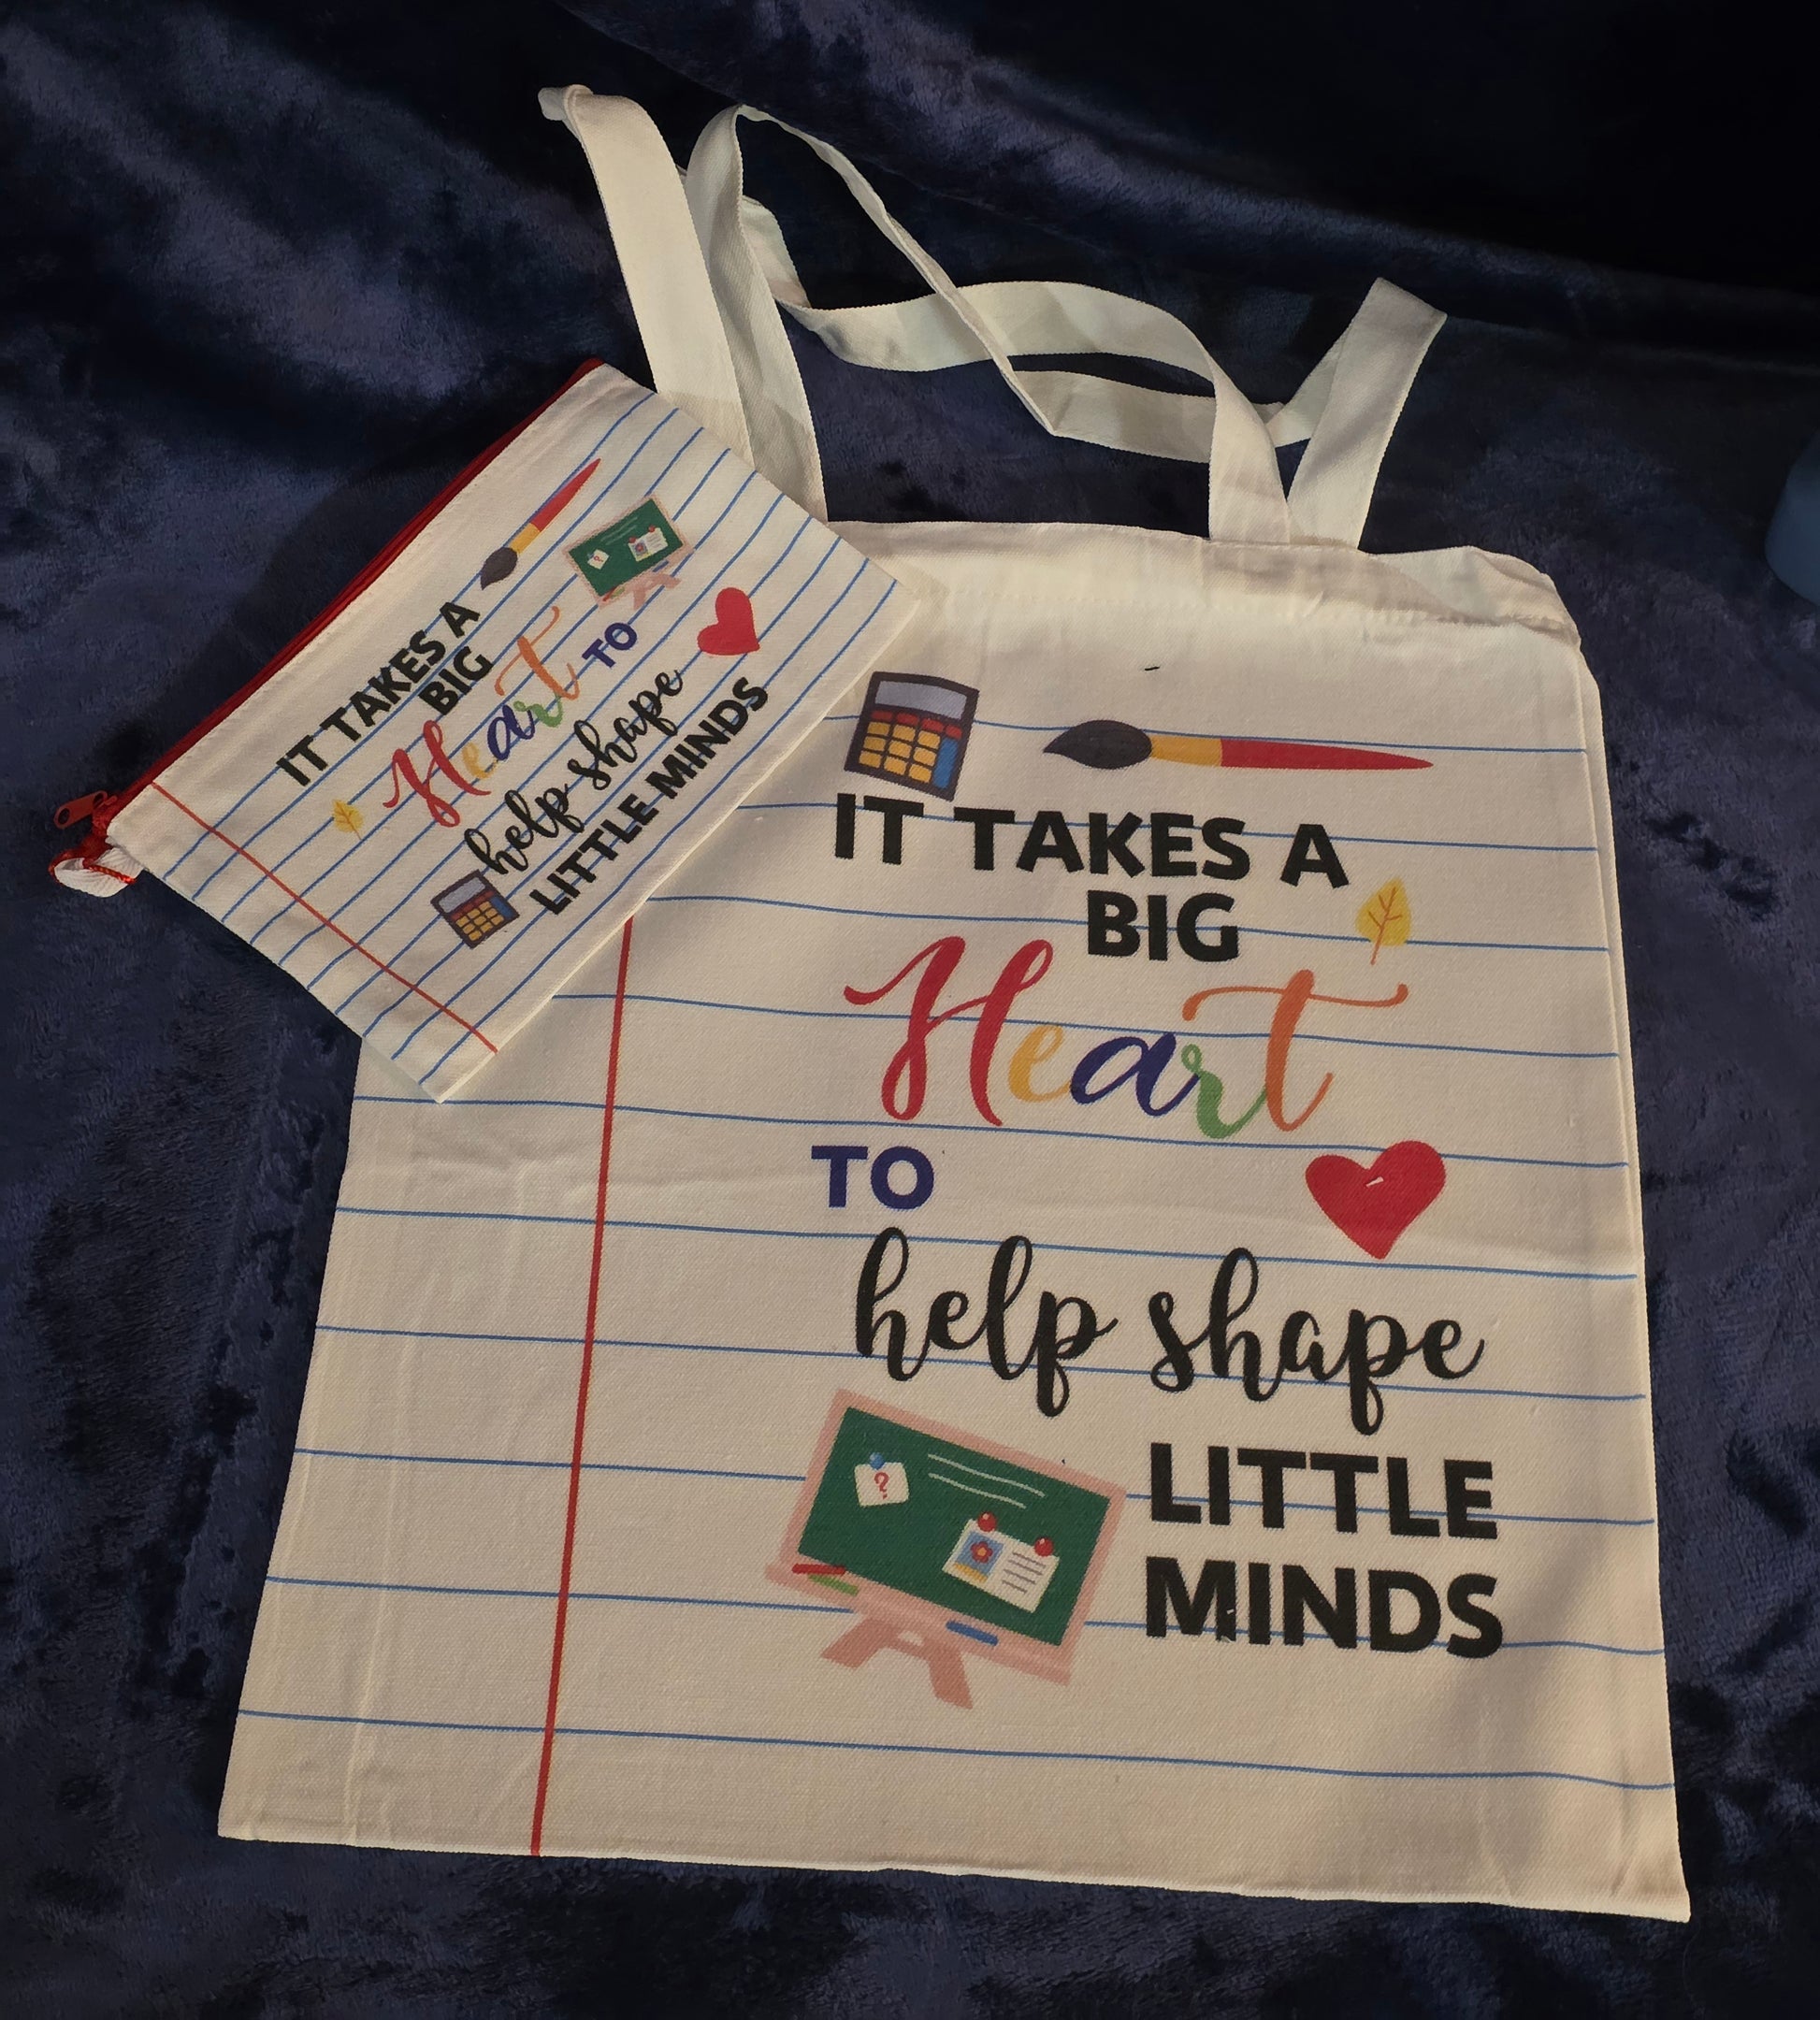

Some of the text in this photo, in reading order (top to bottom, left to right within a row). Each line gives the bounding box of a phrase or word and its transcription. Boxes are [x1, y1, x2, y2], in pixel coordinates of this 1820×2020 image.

[276, 601, 481, 786] IT TAKES A
[383, 606, 638, 828] Heart TO
[419, 646, 493, 715] BIG
[464, 670, 683, 874] help shape
[529, 676, 769, 915] LITTLE MINDS
[833, 793, 1350, 889] IT TAKES A
[1087, 889, 1239, 962] BIG
[844, 936, 1408, 1140] Heart
[811, 1146, 935, 1210] TO
[855, 1227, 1485, 1436] help shape
[1149, 1442, 1498, 1539] LITTLE
[1146, 1556, 1503, 1659] MINDS
